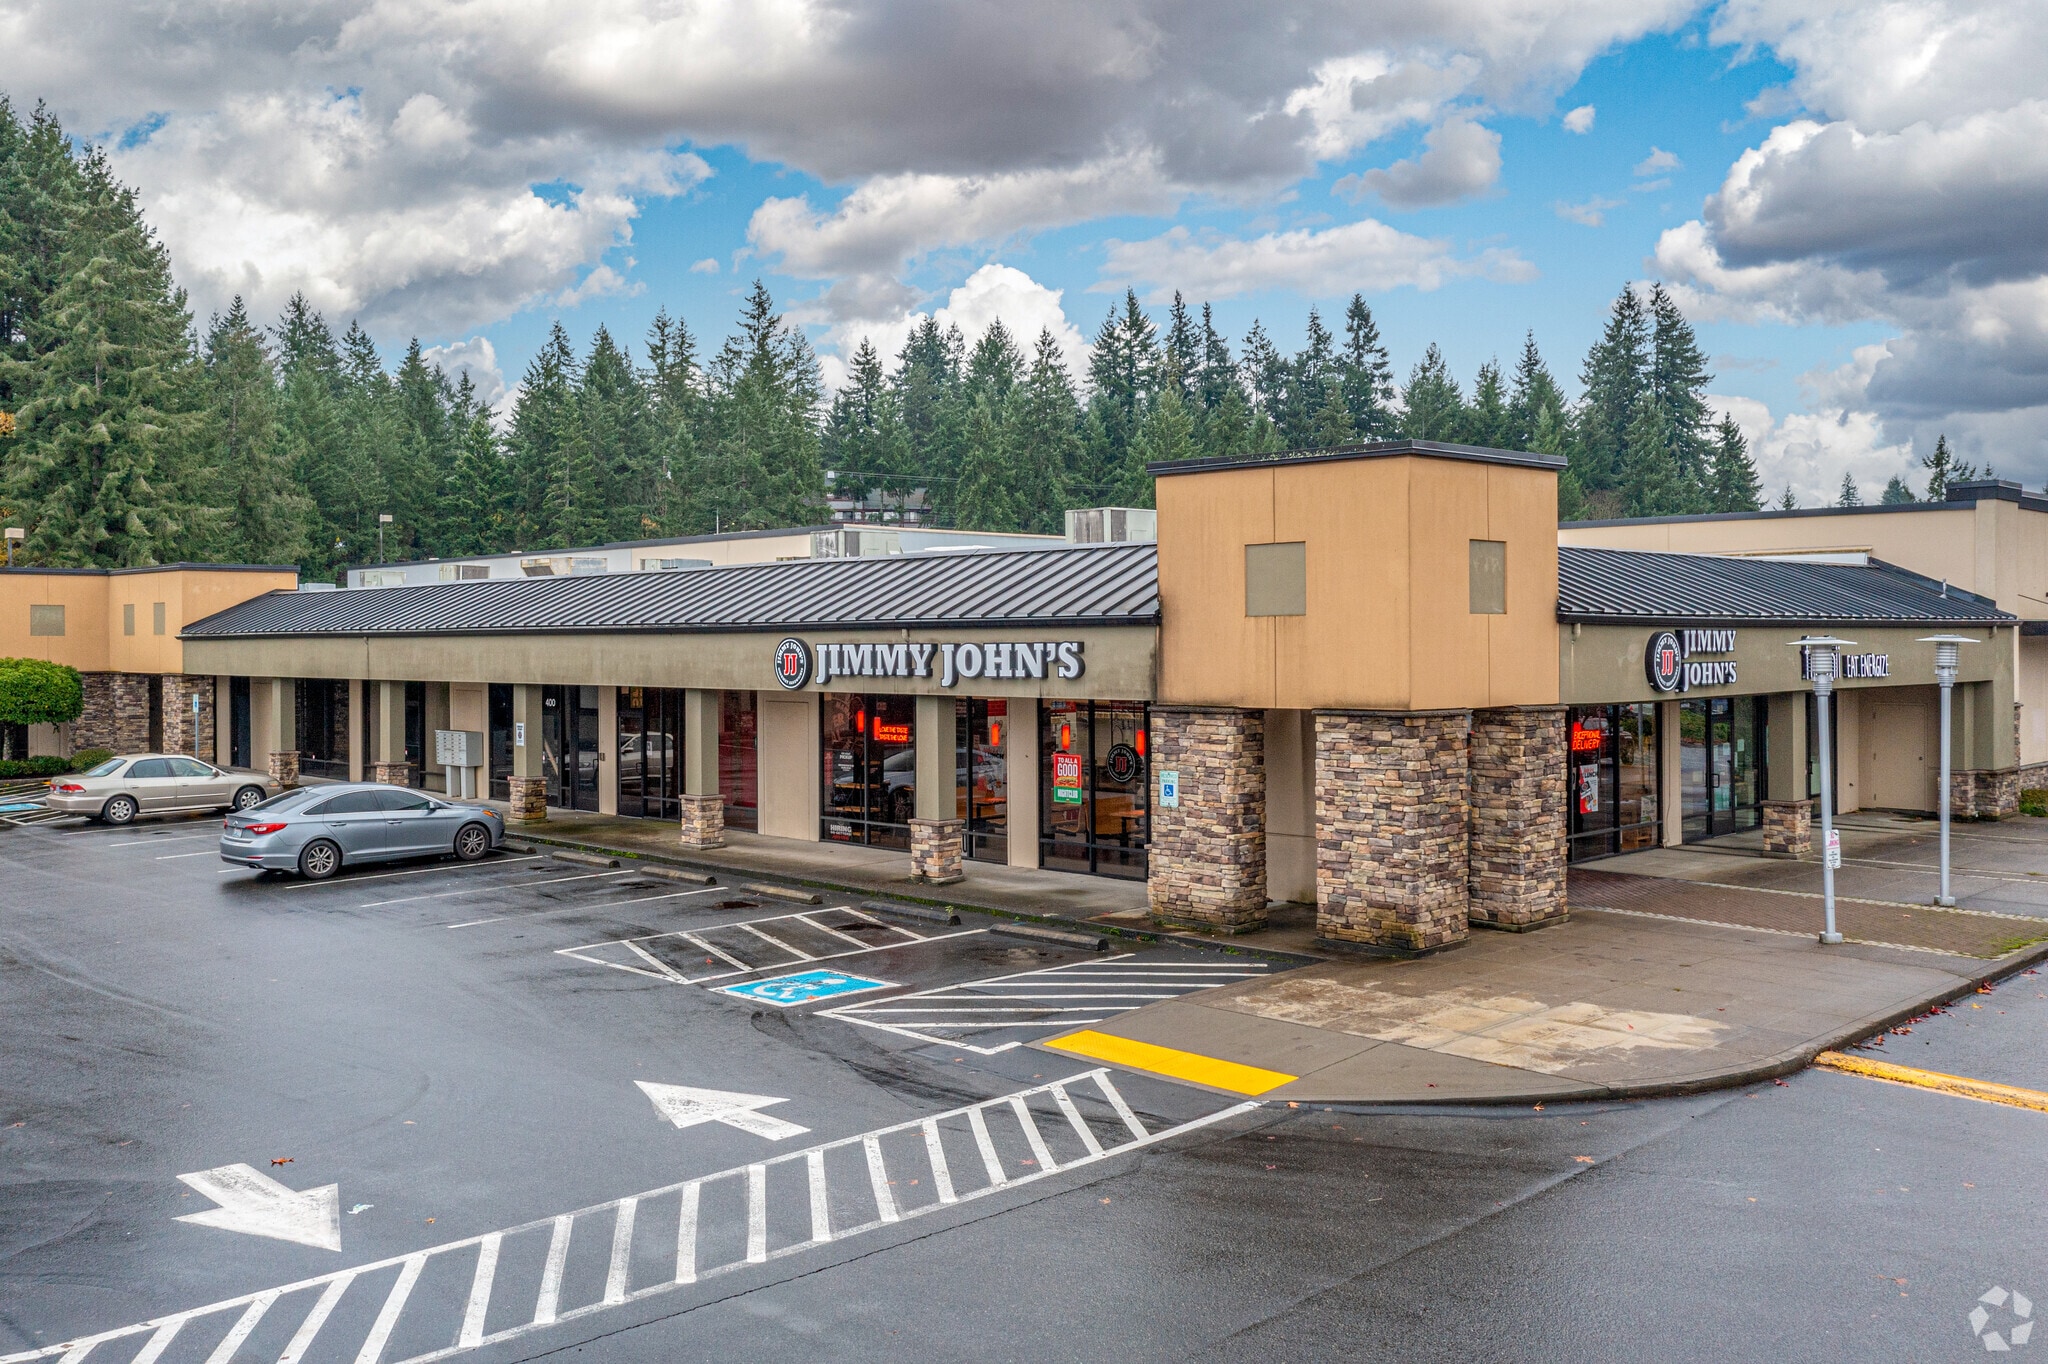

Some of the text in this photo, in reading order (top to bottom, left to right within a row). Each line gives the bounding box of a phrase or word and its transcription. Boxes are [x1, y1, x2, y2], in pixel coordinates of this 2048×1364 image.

[777, 642, 804, 664] JIMMY JOHN'S
[1656, 637, 1667, 662] JIMMY
[1684, 630, 1736, 658] JIMMY
[783, 653, 797, 676] JJ
[816, 643, 934, 685] JIMMY
[941, 641, 1084, 687] JOHN'S
[1661, 650, 1673, 675] JJ
[1684, 662, 1737, 692] JOHN'S
[545, 698, 556, 707] 400
[1572, 739, 1600, 750] DELIVERY
[1573, 731, 1601, 739] EXCEPTIONAL
[1057, 763, 1078, 777] GOOD
[1115, 756, 1127, 773] JJ
[830, 824, 852, 832] HIRING
